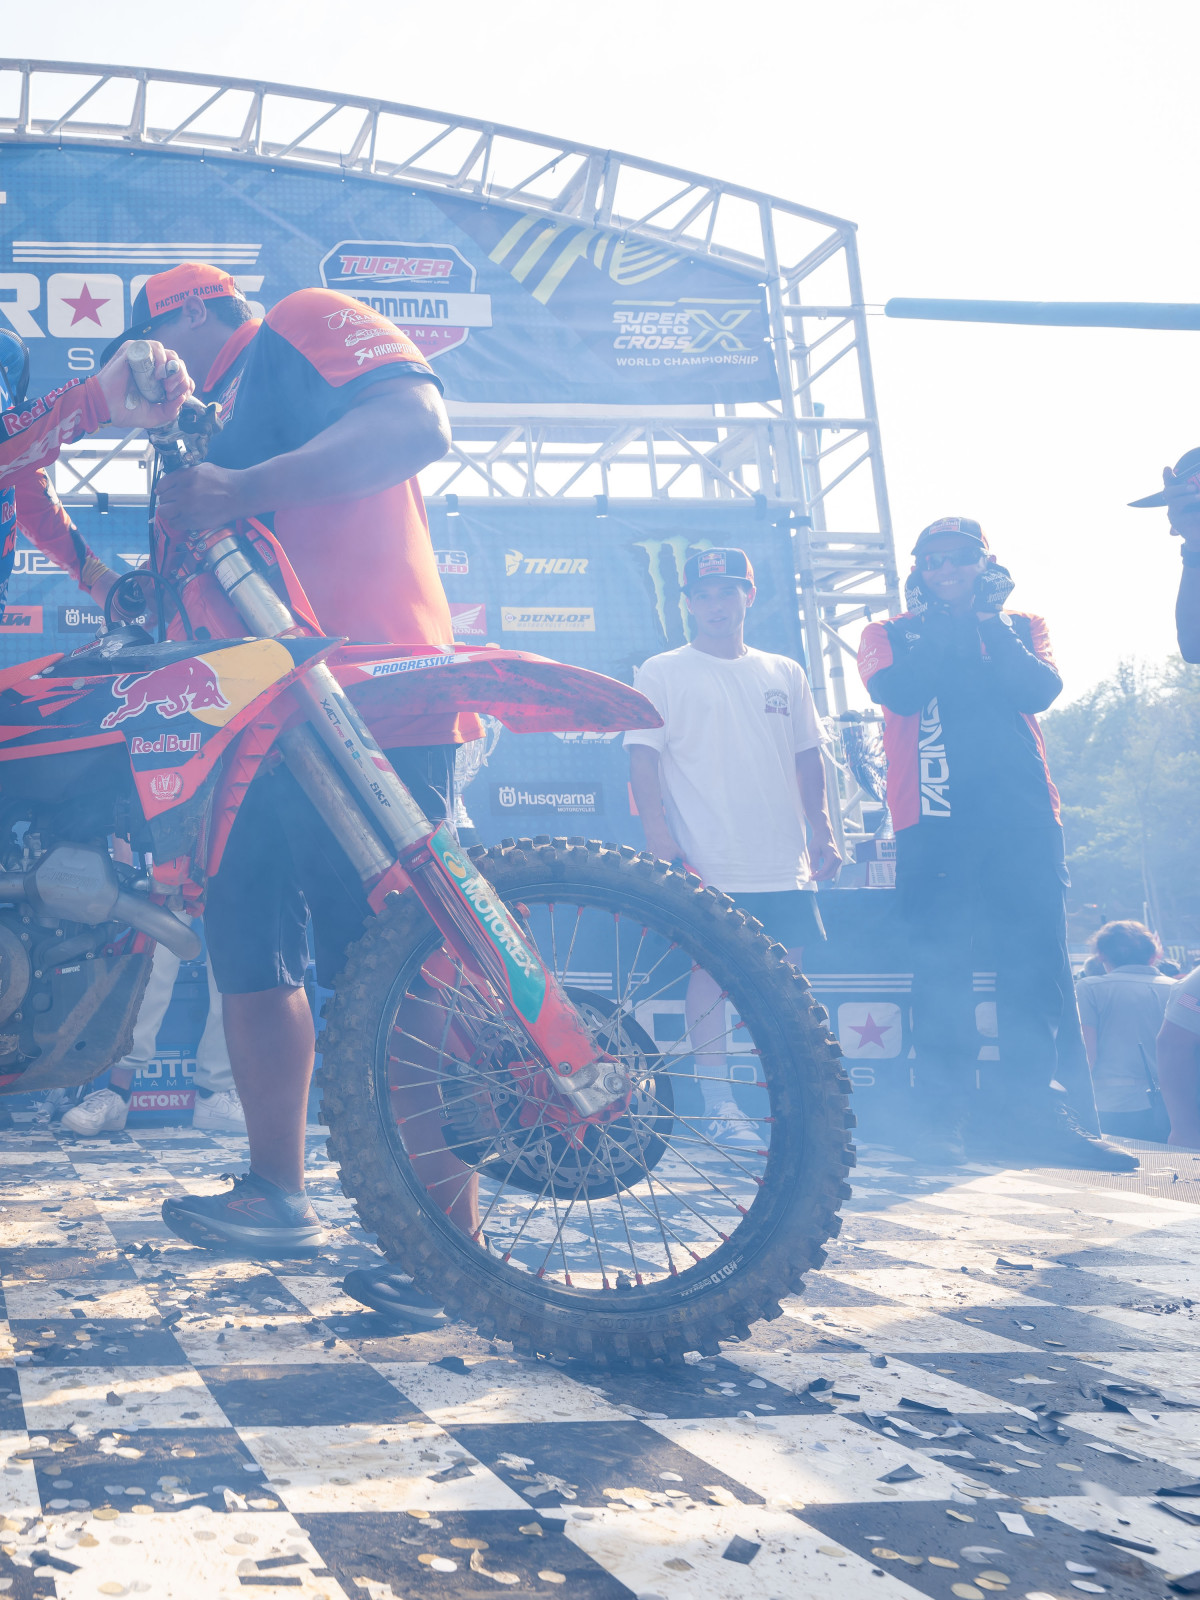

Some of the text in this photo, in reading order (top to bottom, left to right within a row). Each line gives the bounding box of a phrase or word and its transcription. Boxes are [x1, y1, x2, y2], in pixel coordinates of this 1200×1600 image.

[339, 255, 453, 277] TUCKER
[155, 284, 224, 310] FACTORY RACING
[612, 311, 691, 325] SUPER
[619, 325, 689, 335] MOTO
[613, 335, 693, 350] CROSS
[616, 355, 759, 367] WORLD CHAMPIONSHIP
[2, 397, 47, 436] Red
[523, 558, 589, 575] THOR
[518, 614, 591, 623] DUNLOP
[372, 654, 455, 676] PROGRESSIVE
[320, 698, 341, 725] XACT
[131, 733, 201, 754] Red Bull
[919, 696, 951, 817] RACING
[370, 781, 391, 808] SKF
[518, 791, 596, 807] Husqvarna
[460, 877, 539, 978] MOTOREX
[133, 1093, 191, 1108] ICTORY
